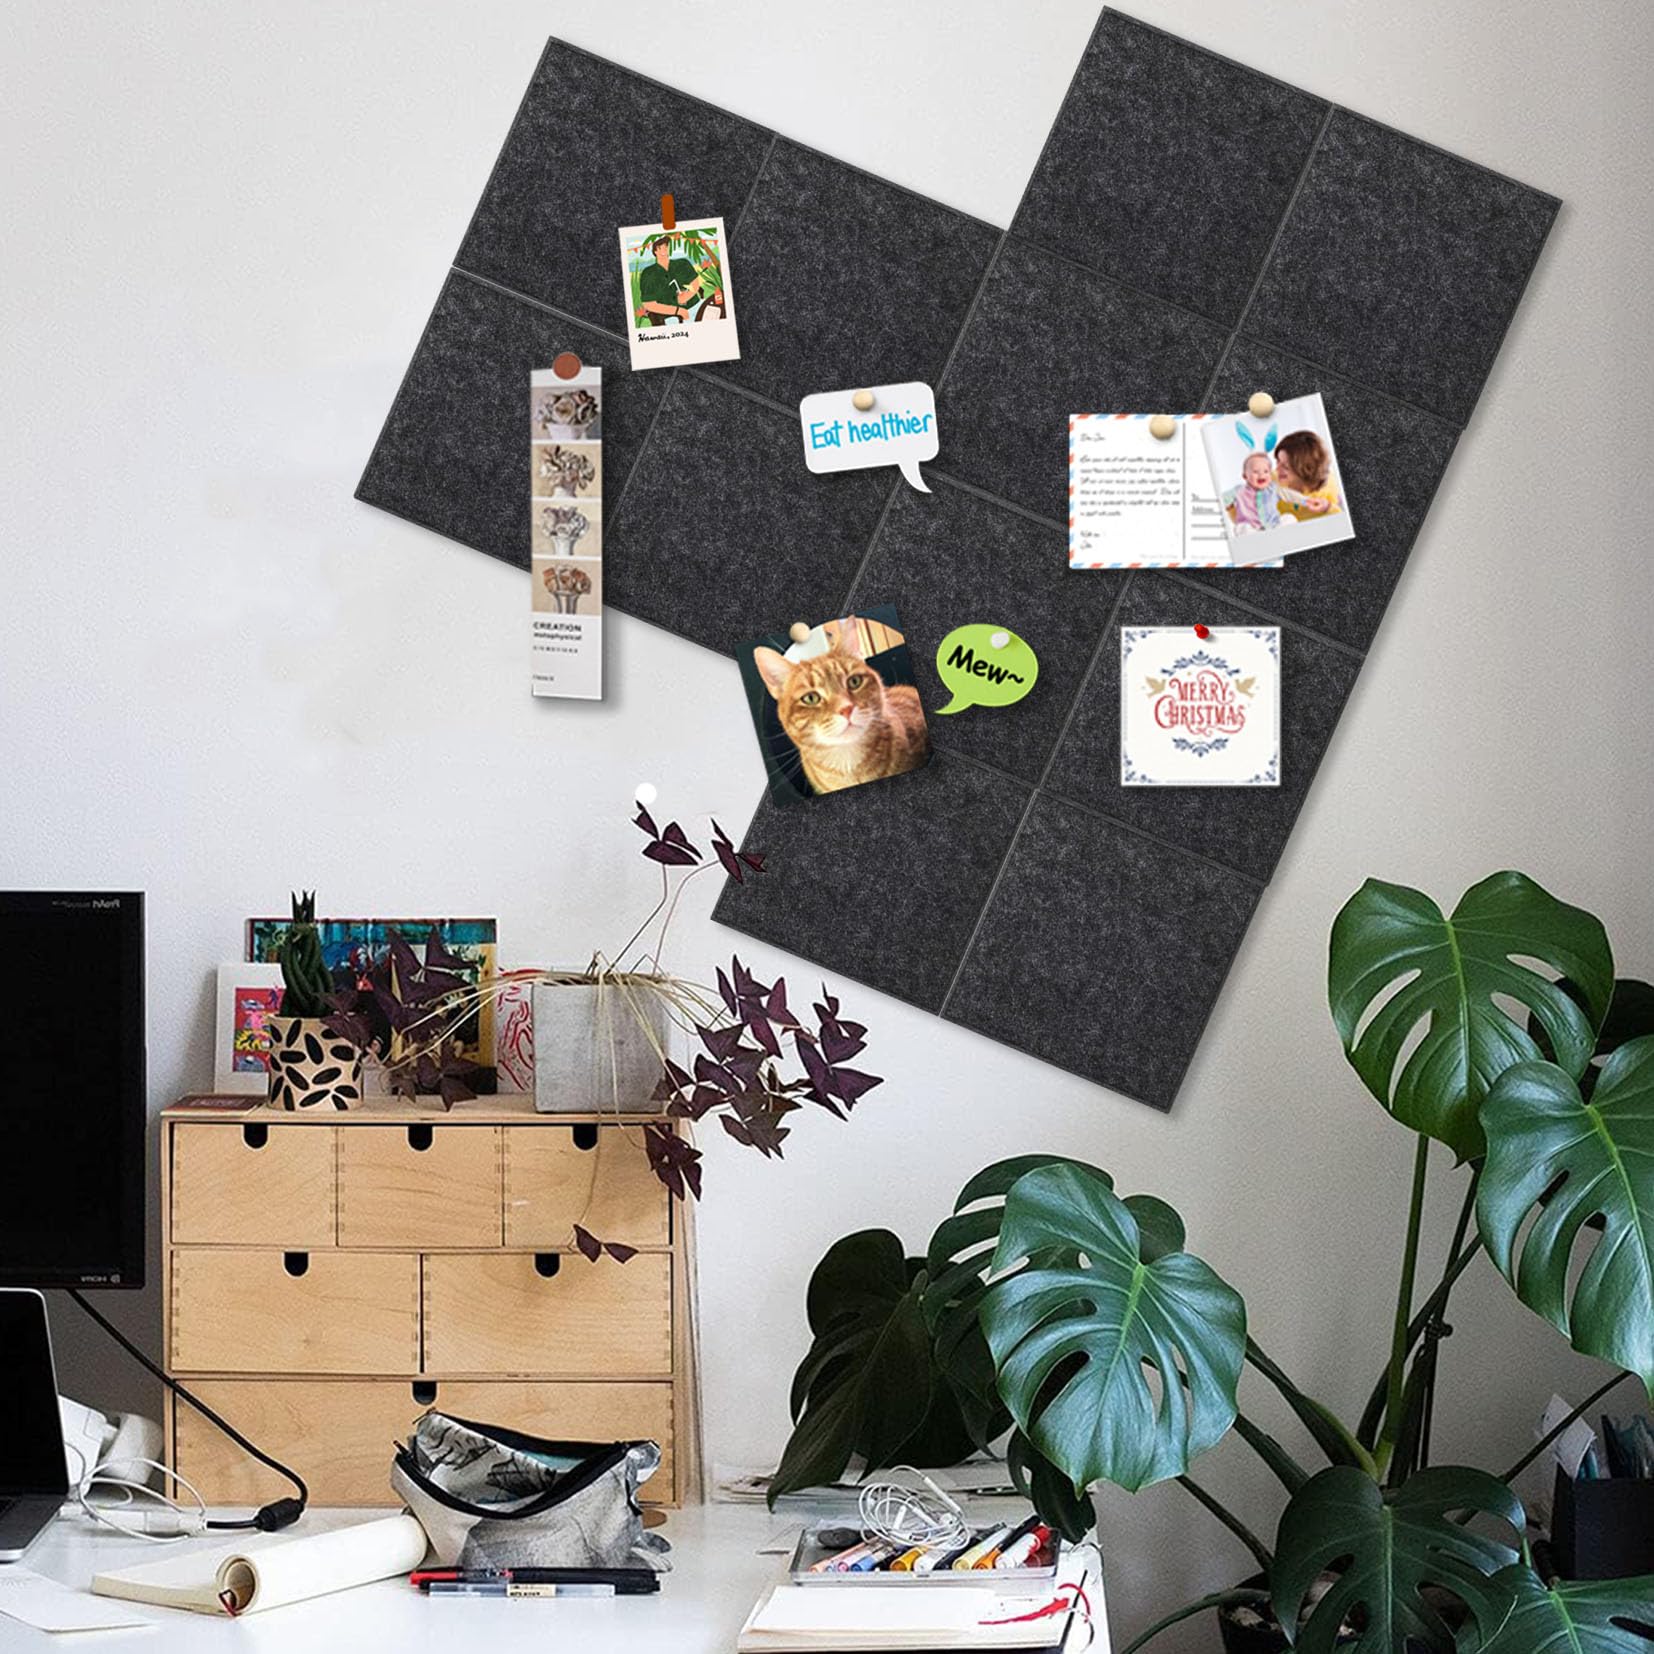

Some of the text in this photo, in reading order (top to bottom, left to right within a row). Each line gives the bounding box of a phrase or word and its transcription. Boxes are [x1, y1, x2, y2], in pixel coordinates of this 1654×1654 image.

[809, 410, 933, 450] Eat healthier
[533, 621, 582, 632] CREATION
[1168, 669, 1235, 706] MERRY
[1154, 694, 1247, 738] CHRISTMAS
